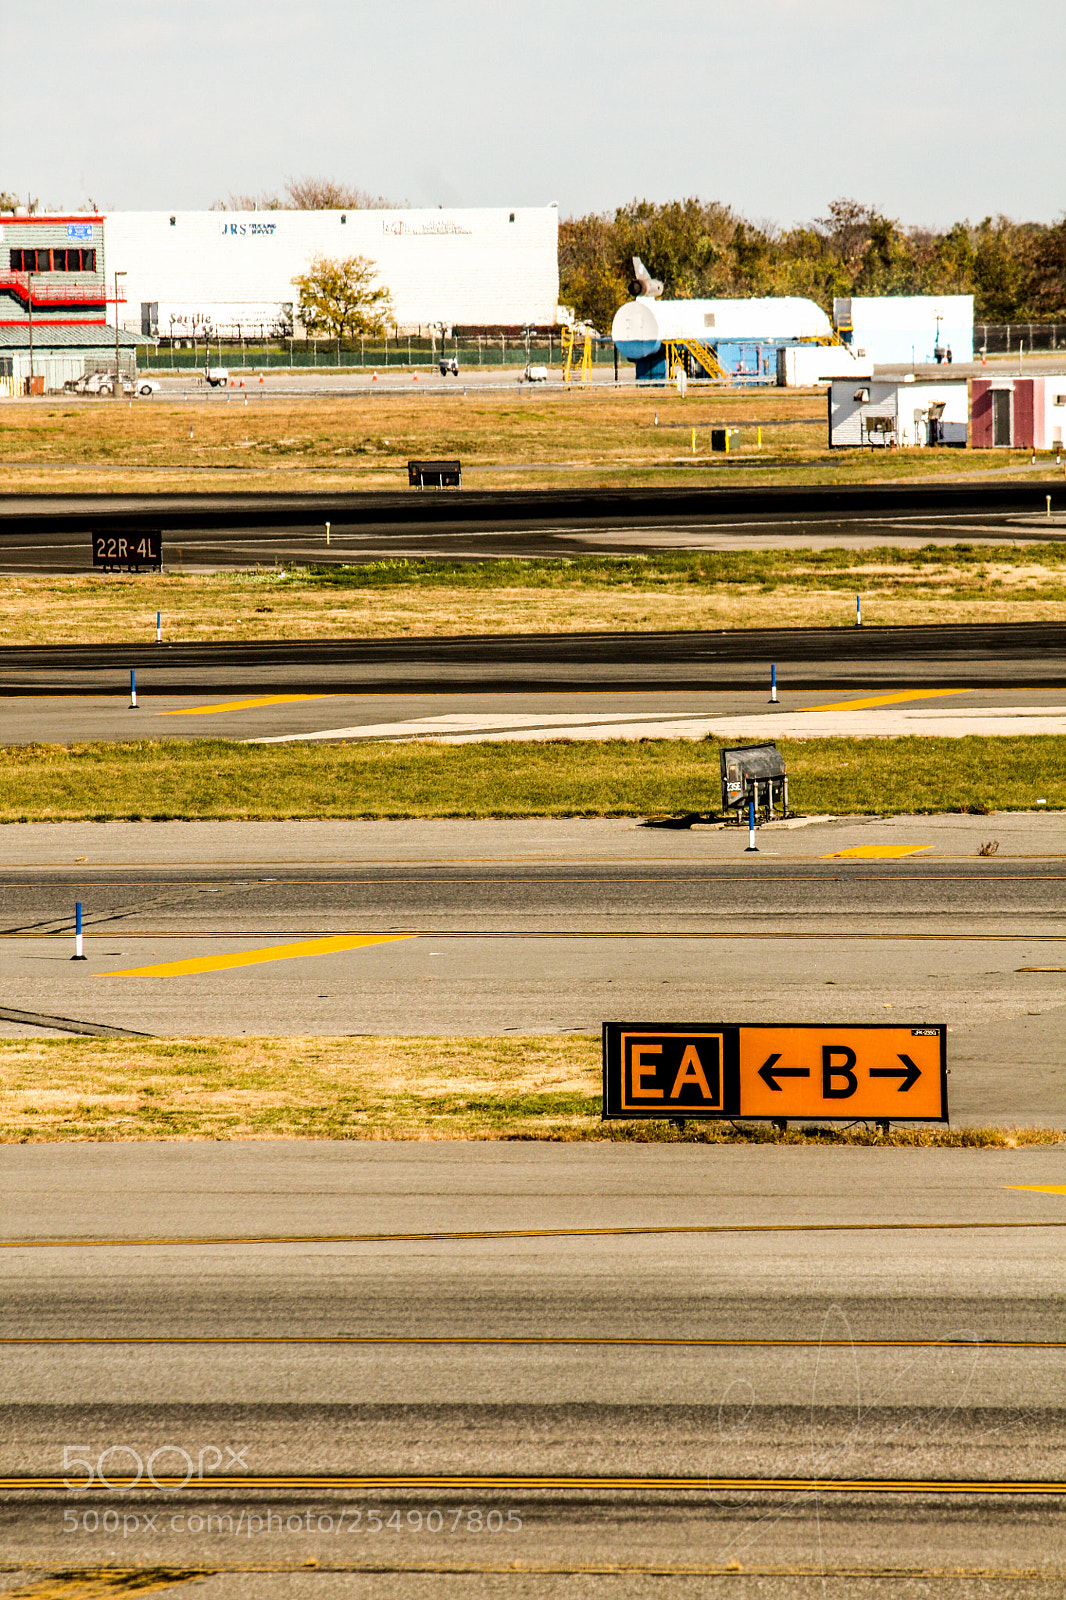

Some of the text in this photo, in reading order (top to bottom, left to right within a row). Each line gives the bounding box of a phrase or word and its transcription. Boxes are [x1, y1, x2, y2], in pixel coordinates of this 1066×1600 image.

[222, 223, 246, 235] JRS
[169, 313, 211, 325] Seville
[97, 538, 157, 558] 22R-4L
[631, 1044, 858, 1099] EA B
